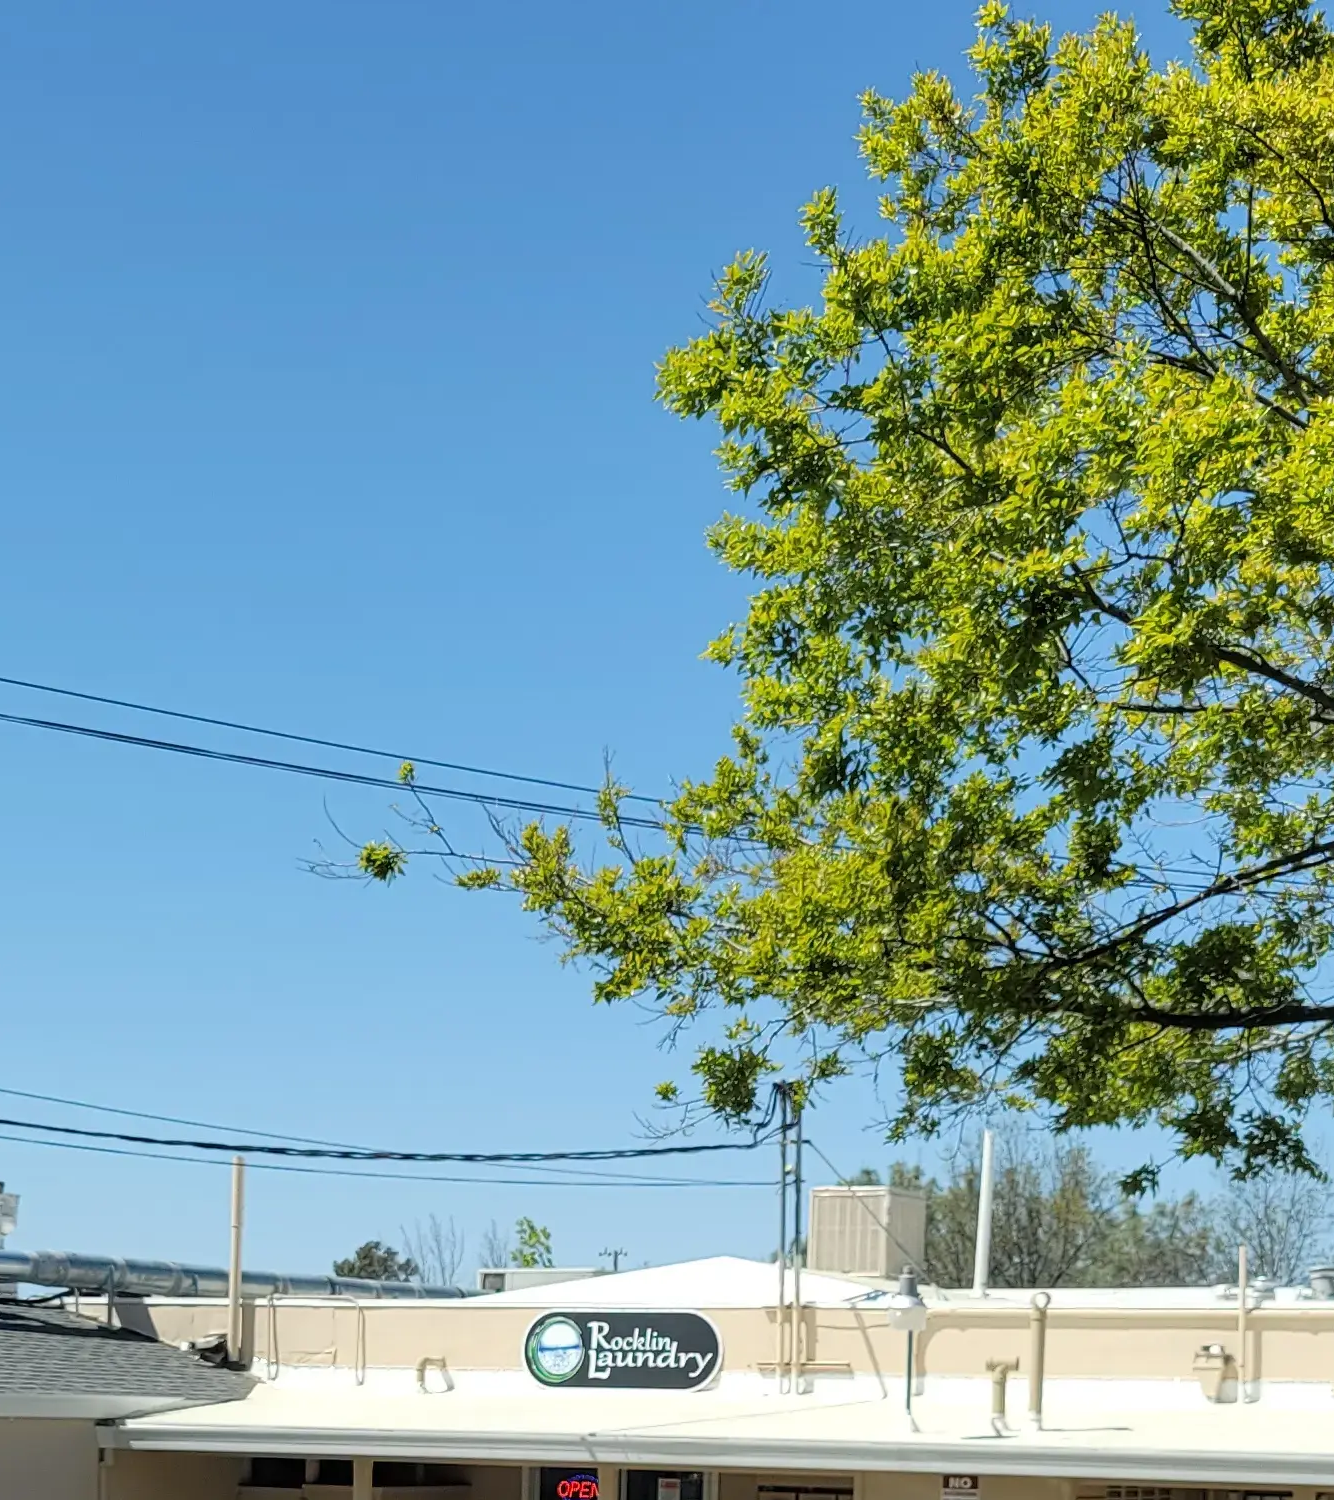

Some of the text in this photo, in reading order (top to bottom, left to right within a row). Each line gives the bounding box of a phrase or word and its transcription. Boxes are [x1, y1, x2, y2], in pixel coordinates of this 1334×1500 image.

[587, 1321, 671, 1351] Rocklin
[588, 1341, 713, 1379] Laundry
[558, 1481, 599, 1498] OPEN
[949, 1477, 971, 1488] NO
